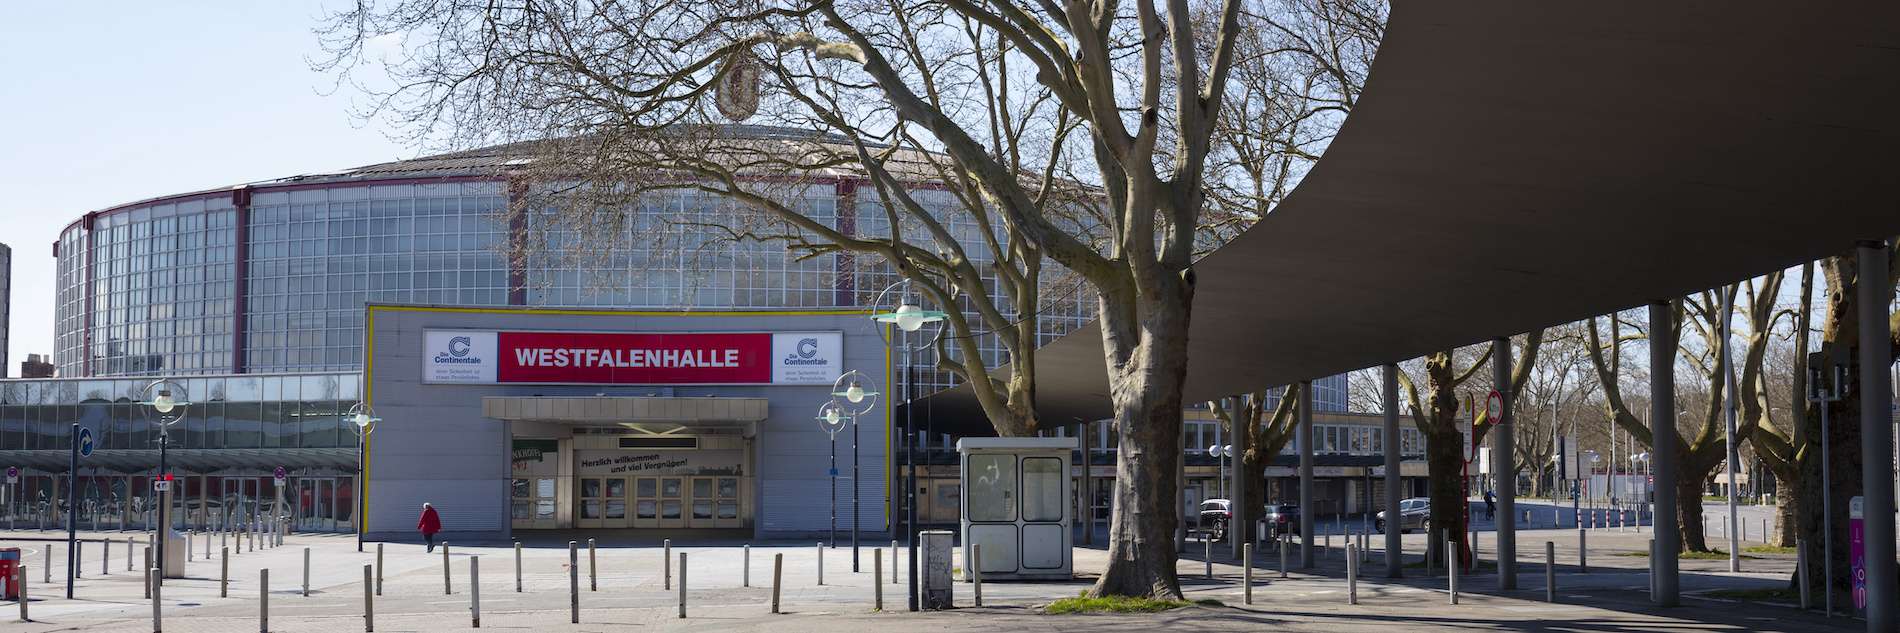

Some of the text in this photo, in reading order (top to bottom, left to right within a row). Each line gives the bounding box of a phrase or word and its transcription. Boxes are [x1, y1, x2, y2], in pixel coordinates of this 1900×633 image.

[434, 356, 482, 364] Continentale
[514, 348, 740, 367] WESTFALENHALLE
[581, 453, 660, 468] Herzlich willkommen
[611, 465, 626, 473] und
[628, 463, 642, 471] viel
